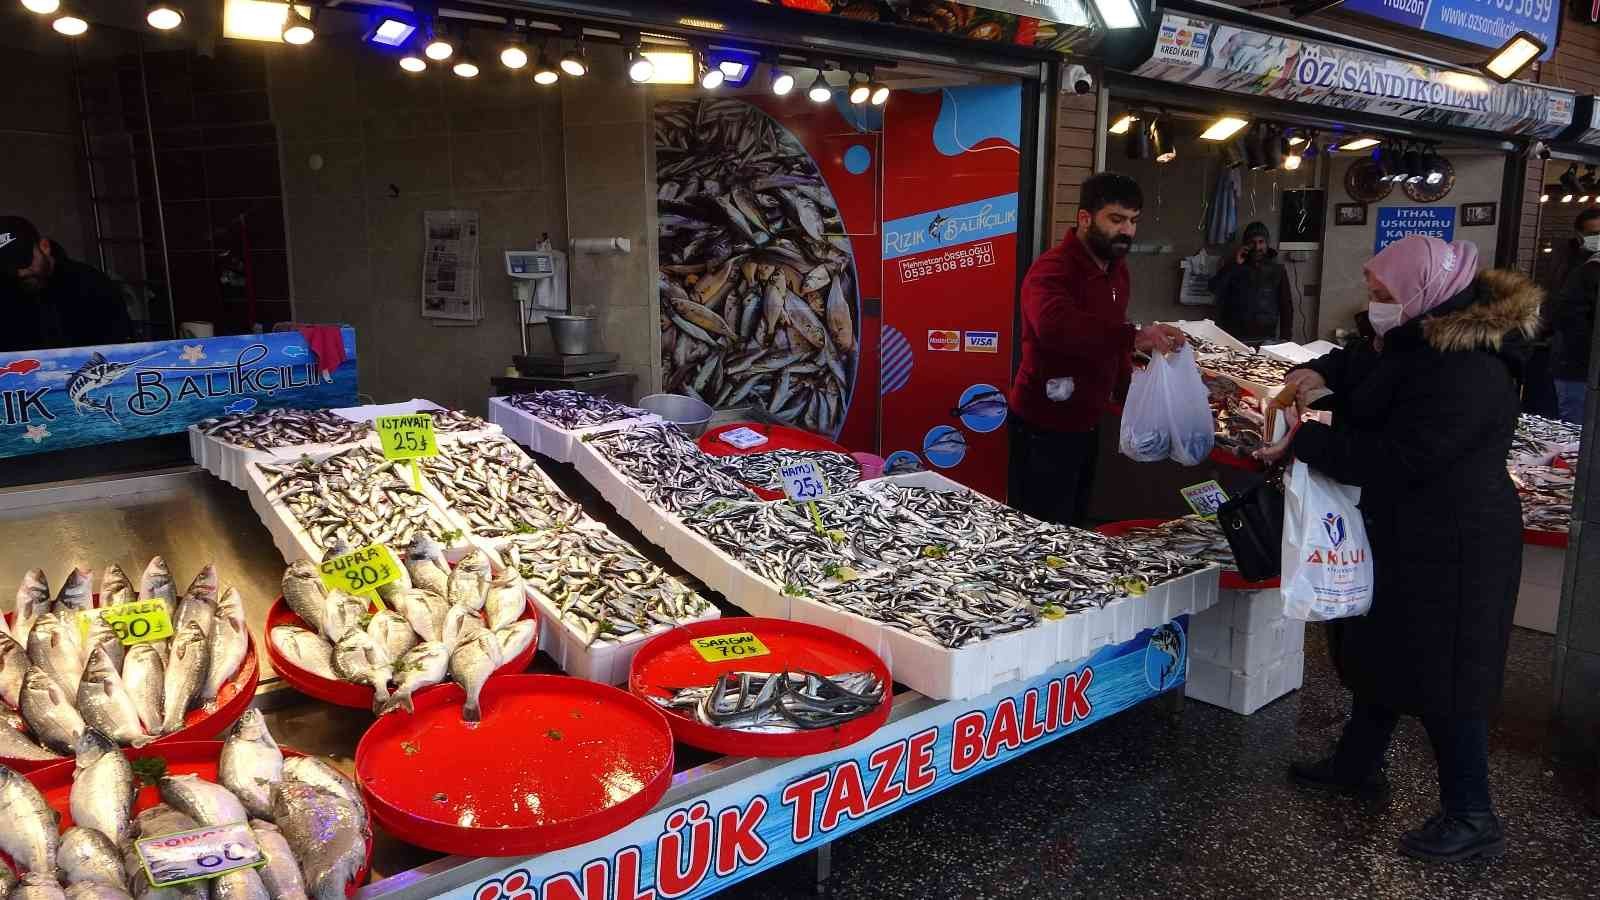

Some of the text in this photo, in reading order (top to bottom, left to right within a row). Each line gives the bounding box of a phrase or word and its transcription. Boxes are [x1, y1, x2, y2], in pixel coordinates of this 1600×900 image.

[1299, 49, 1335, 88] ÖZ
[1381, 220, 1451, 228] USKUMRU
[904, 253, 992, 280] 0532 308 28 70
[970, 336, 993, 346] VISA
[0, 386, 57, 425] IK
[697, 635, 754, 648] SARGAN
[783, 727, 938, 842] TAZE
[950, 667, 1093, 774] BALIK
